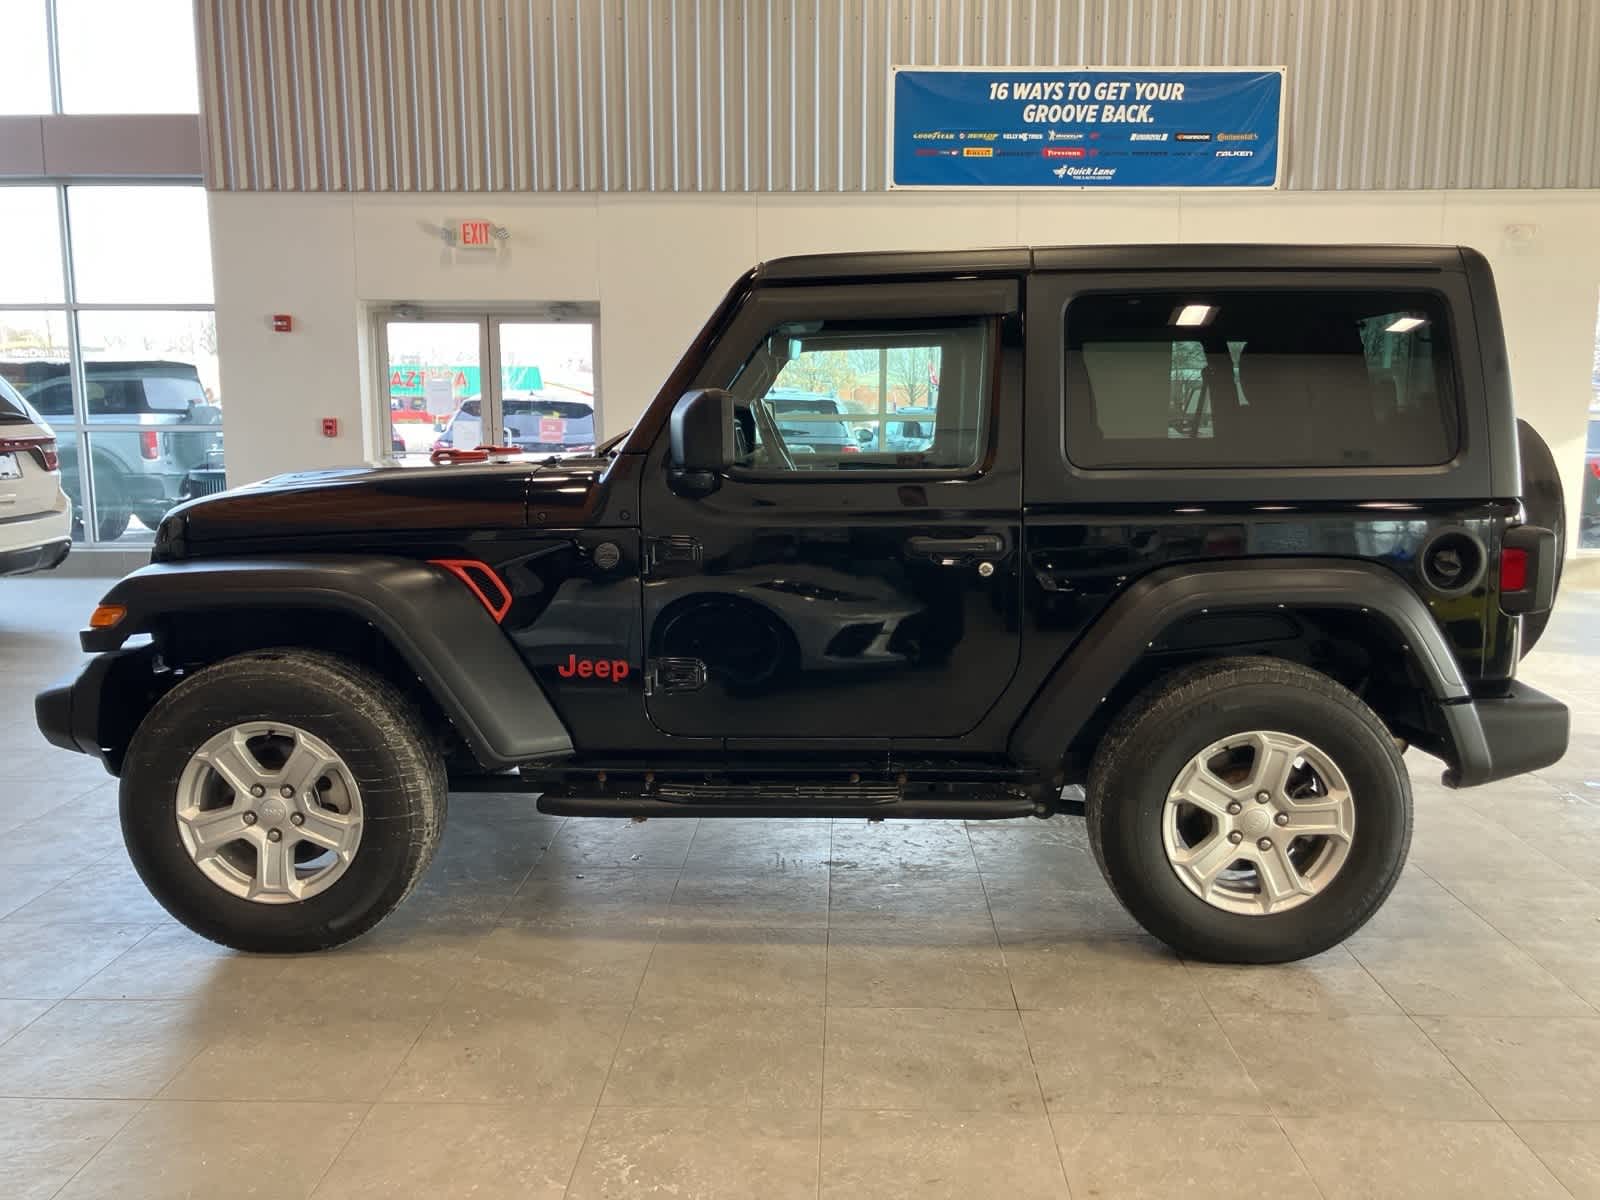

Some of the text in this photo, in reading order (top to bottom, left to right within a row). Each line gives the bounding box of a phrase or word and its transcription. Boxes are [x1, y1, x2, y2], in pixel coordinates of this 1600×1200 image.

[989, 82, 1185, 100] 16 WAYS TO GET YOUR
[1022, 104, 1155, 123] GROOVE BACK.
[1066, 167, 1116, 176] Quick Lane
[463, 223, 489, 244] EXIT
[558, 654, 629, 682] Jeep
